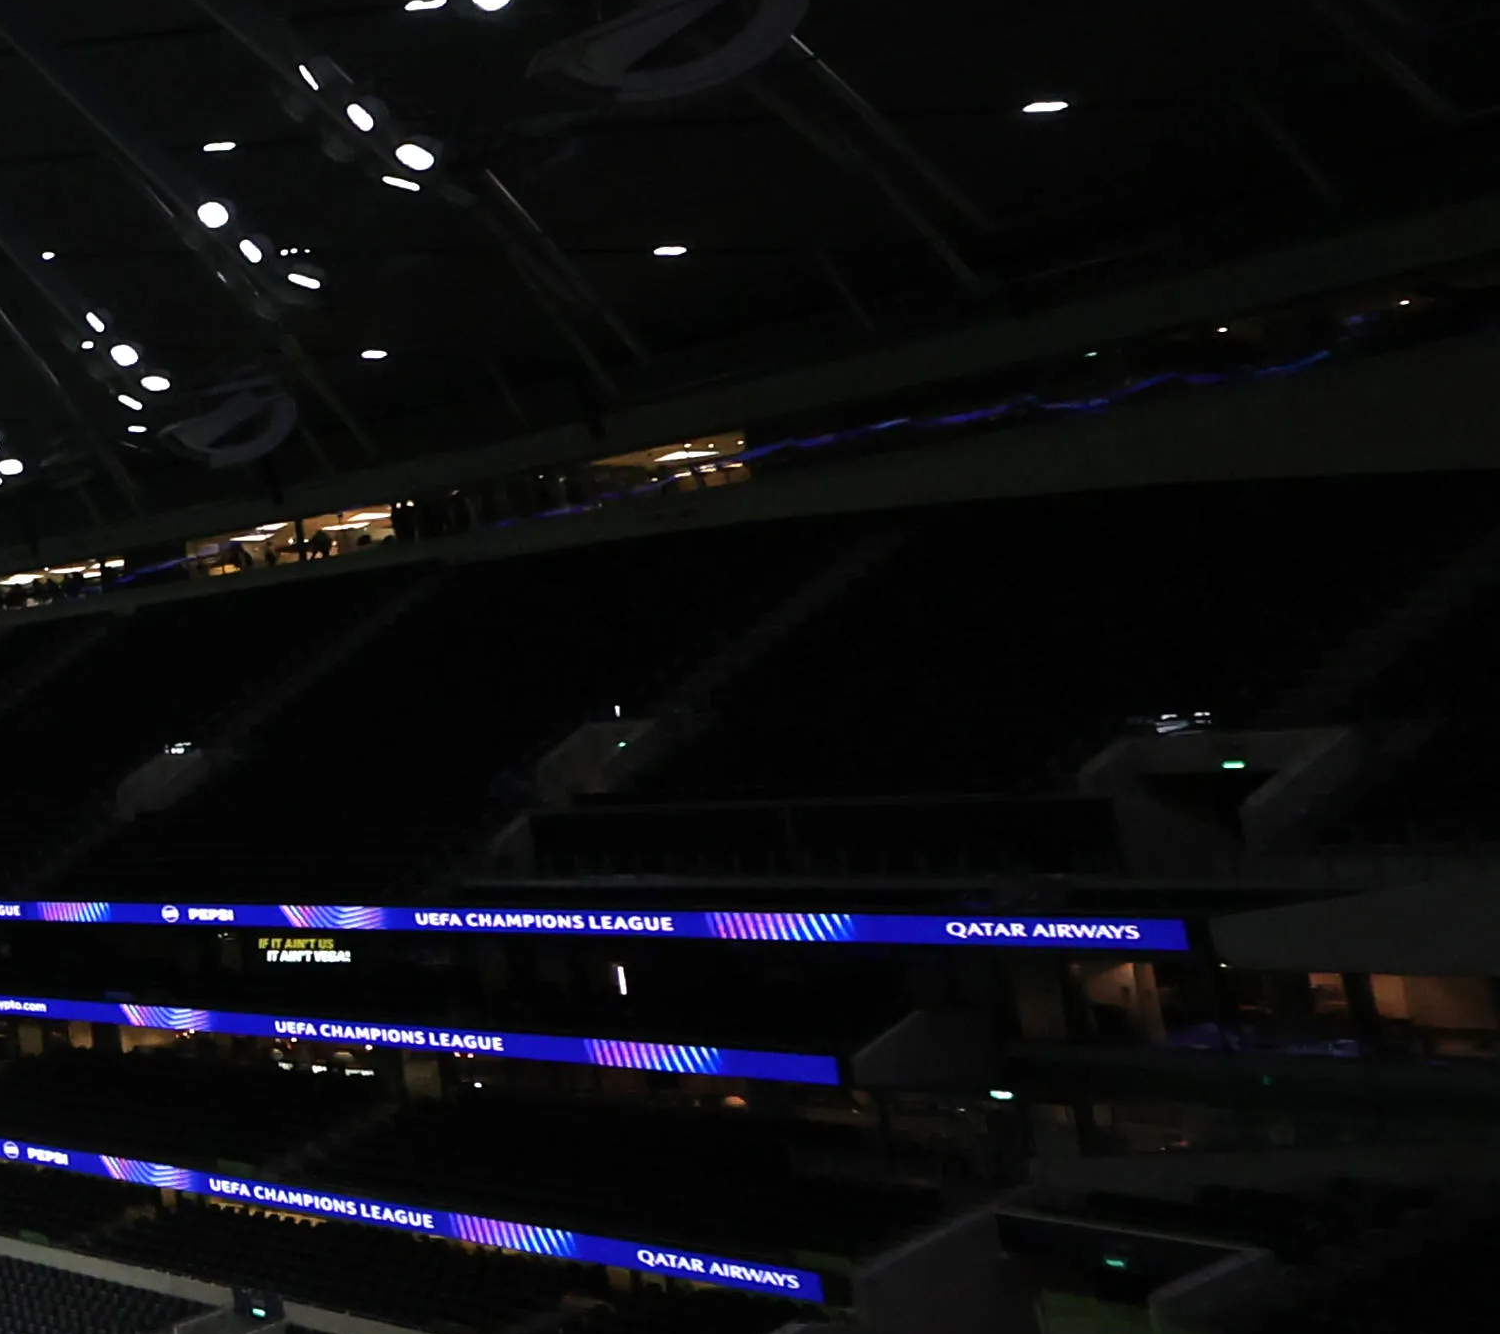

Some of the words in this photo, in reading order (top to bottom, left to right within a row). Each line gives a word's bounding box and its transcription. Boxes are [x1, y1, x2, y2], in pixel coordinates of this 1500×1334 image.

[188, 908, 233, 921] PEPSI
[415, 913, 462, 926] UEFA
[466, 913, 584, 929] CHAMPIONS
[589, 916, 673, 931] LEAGUE
[946, 922, 1026, 938] QATAR
[1033, 924, 1139, 939] AIRWAYS
[275, 1021, 317, 1035] UEFA
[320, 1024, 425, 1044] CHAMPIONS
[429, 1033, 503, 1051] LEAGUE
[27, 1148, 68, 1165] PEPSI
[210, 1178, 250, 1196] UEFA
[254, 1186, 357, 1215] CHAMPIONS
[361, 1204, 434, 1228] LEAGUE
[638, 1250, 705, 1272] QATAR
[710, 1263, 799, 1288] AIRWAYS
